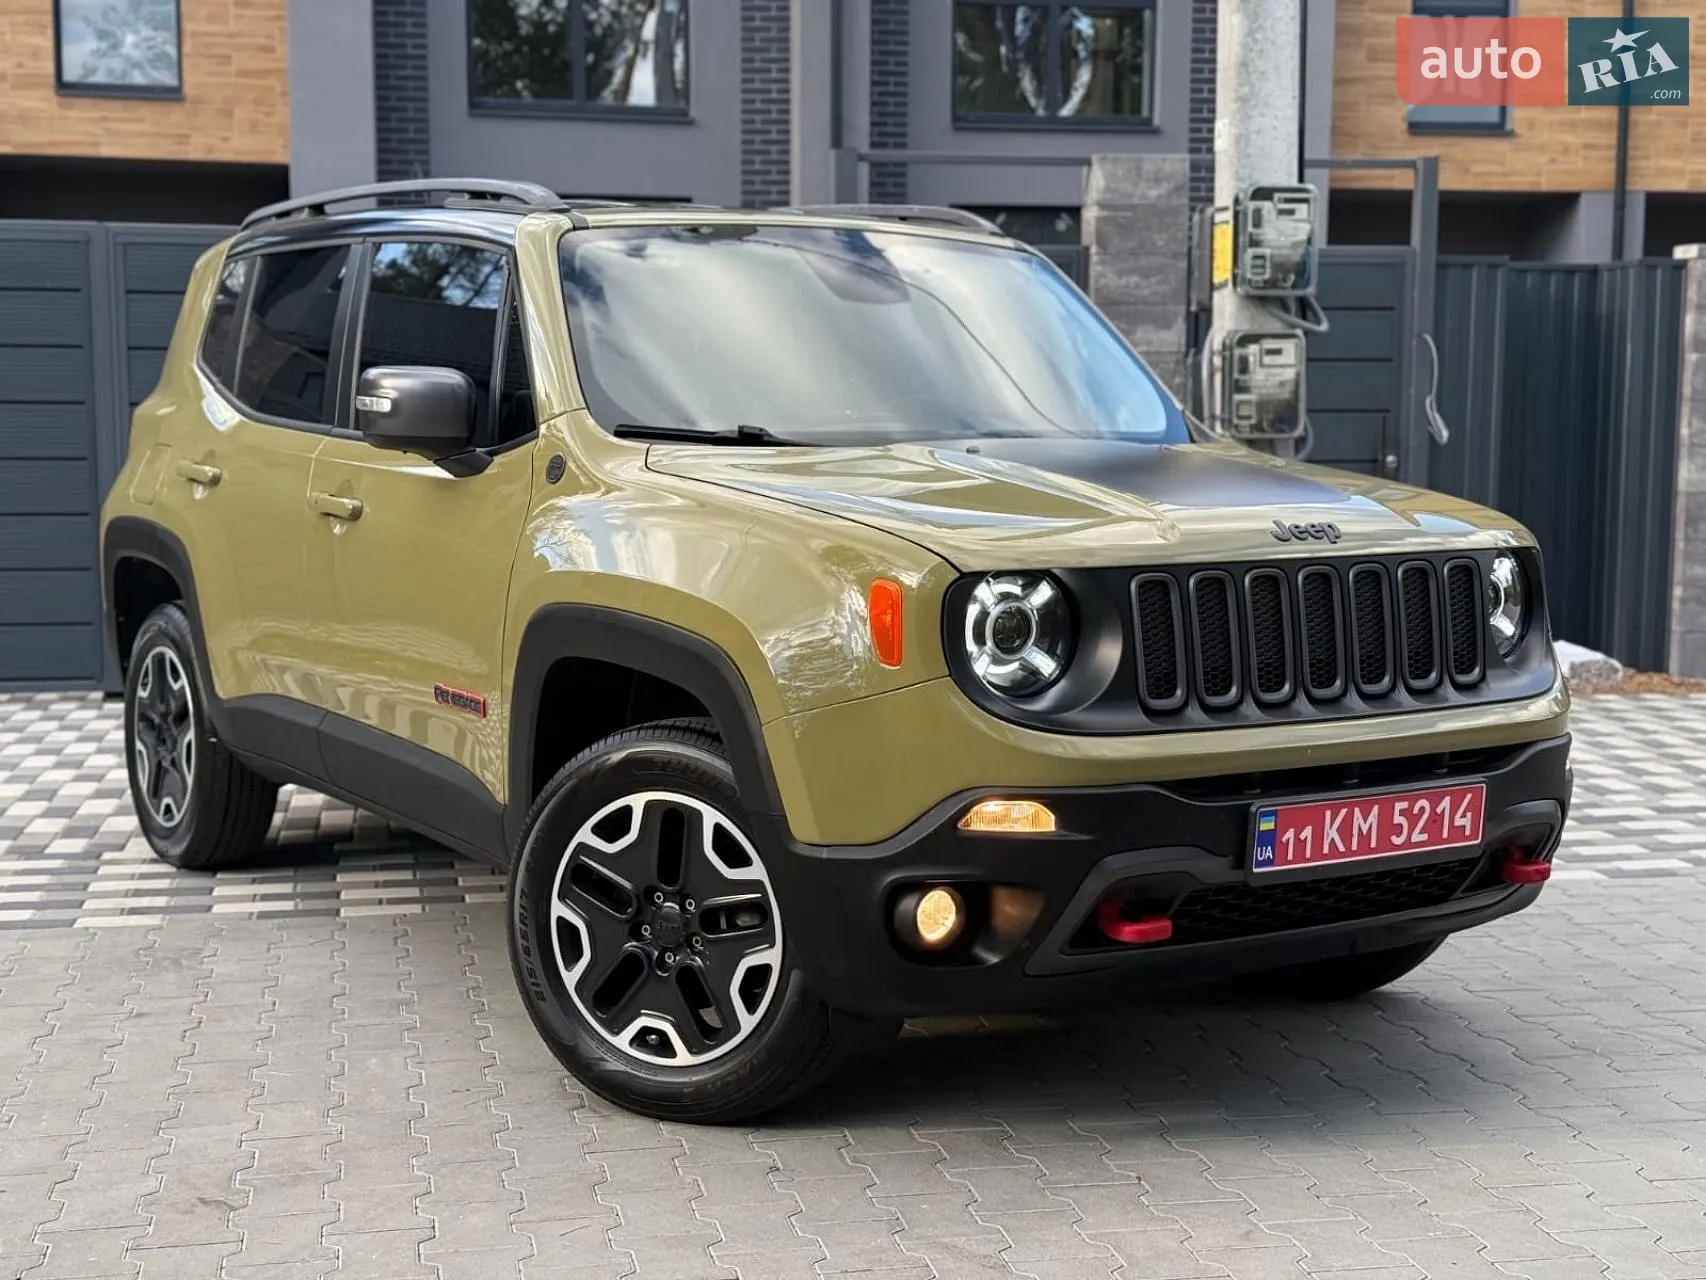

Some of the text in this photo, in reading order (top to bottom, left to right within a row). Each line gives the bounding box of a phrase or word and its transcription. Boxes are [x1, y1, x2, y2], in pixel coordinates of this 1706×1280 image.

[1270, 519, 1342, 544] Jeep
[1281, 793, 1472, 861] 11 KM 5214
[1257, 846, 1273, 861] UA
